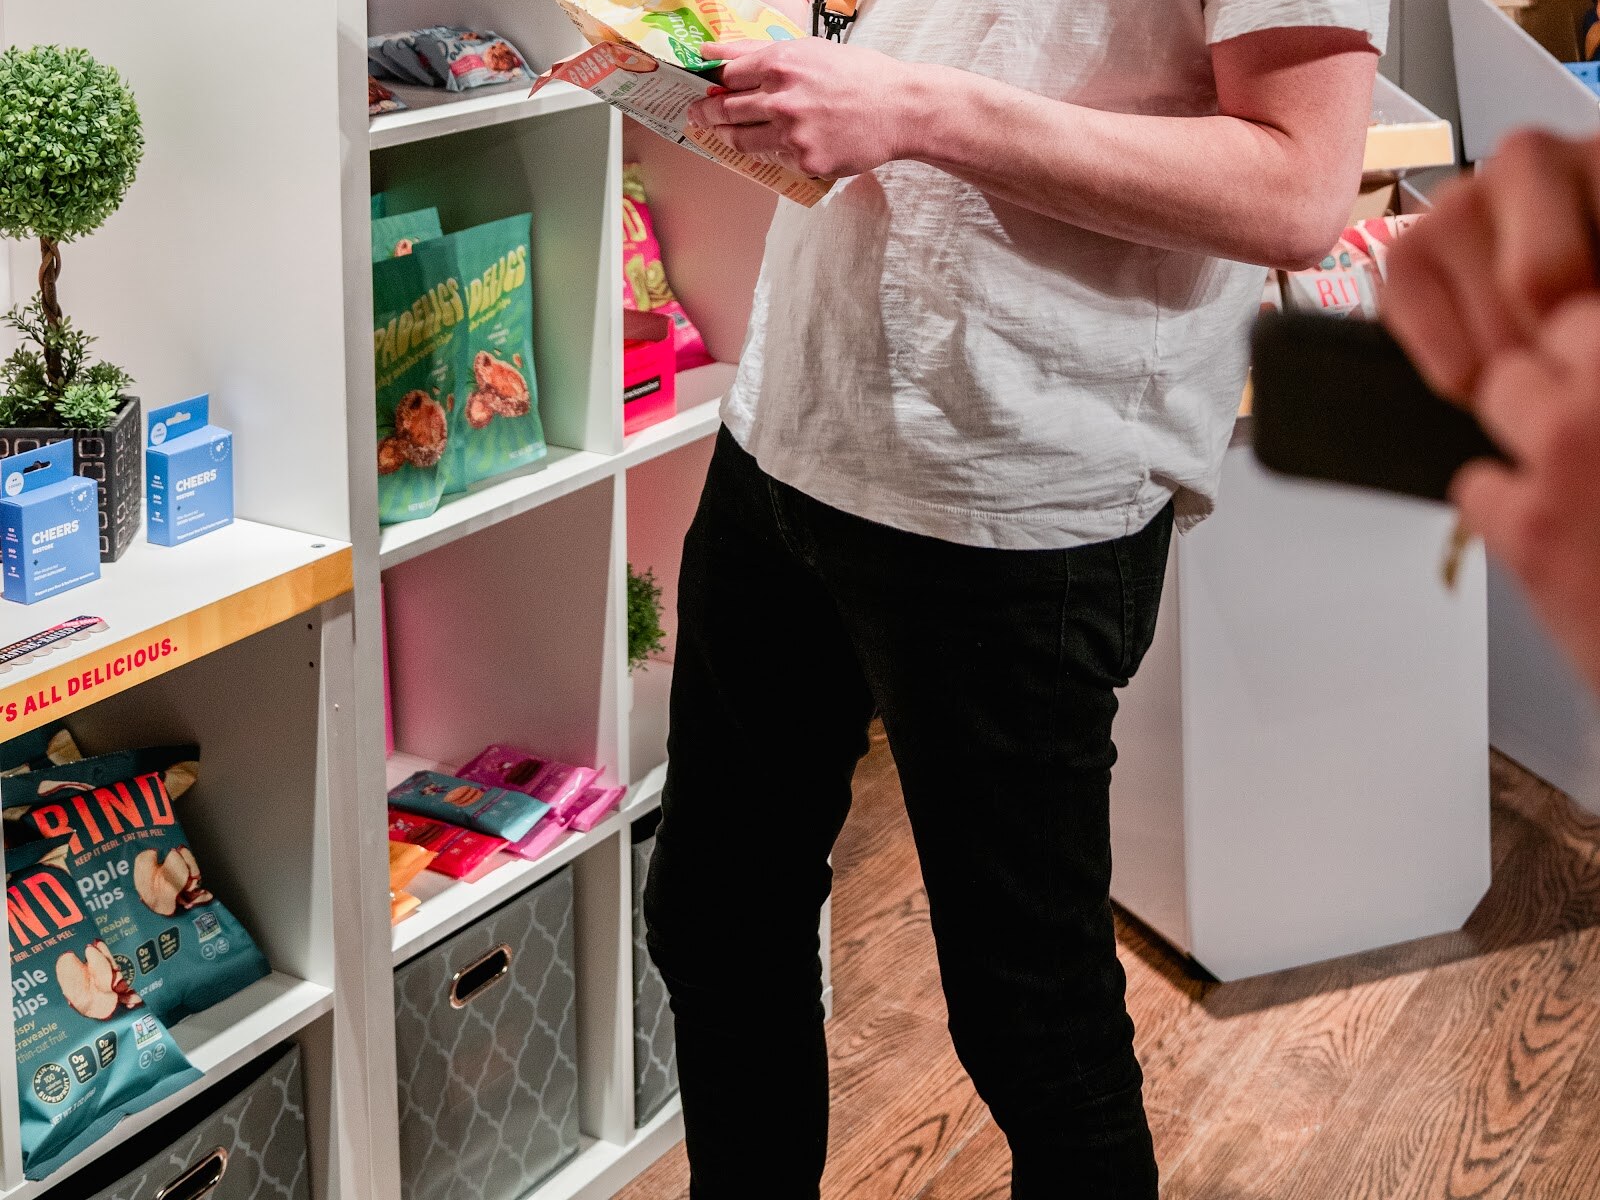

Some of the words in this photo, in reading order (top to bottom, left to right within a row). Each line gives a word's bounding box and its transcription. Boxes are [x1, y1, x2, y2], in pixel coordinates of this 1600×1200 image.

[465, 245, 527, 320] DELICS
[175, 468, 217, 493] CHEERS
[31, 519, 80, 546] CHEERS
[32, 543, 55, 555] RESTORE
[24, 685, 62, 716] ALL
[68, 638, 178, 697] DELICIOUS.
[32, 771, 175, 856] RIND
[75, 851, 91, 867] KEEP
[91, 847, 101, 860] IT
[136, 829, 150, 840] THE
[77, 859, 130, 899] pple
[8, 872, 84, 948] ND
[31, 944, 43, 954] EAT
[43, 936, 58, 948] THE
[49, 1030, 68, 1047] fruit
[98, 1039, 109, 1049] 0g
[71, 1054, 85, 1064] 0g
[34, 1064, 62, 1084] SKIN-ON
[44, 1073, 56, 1084] 100
[38, 1077, 71, 1103] SUPERFRUIT
